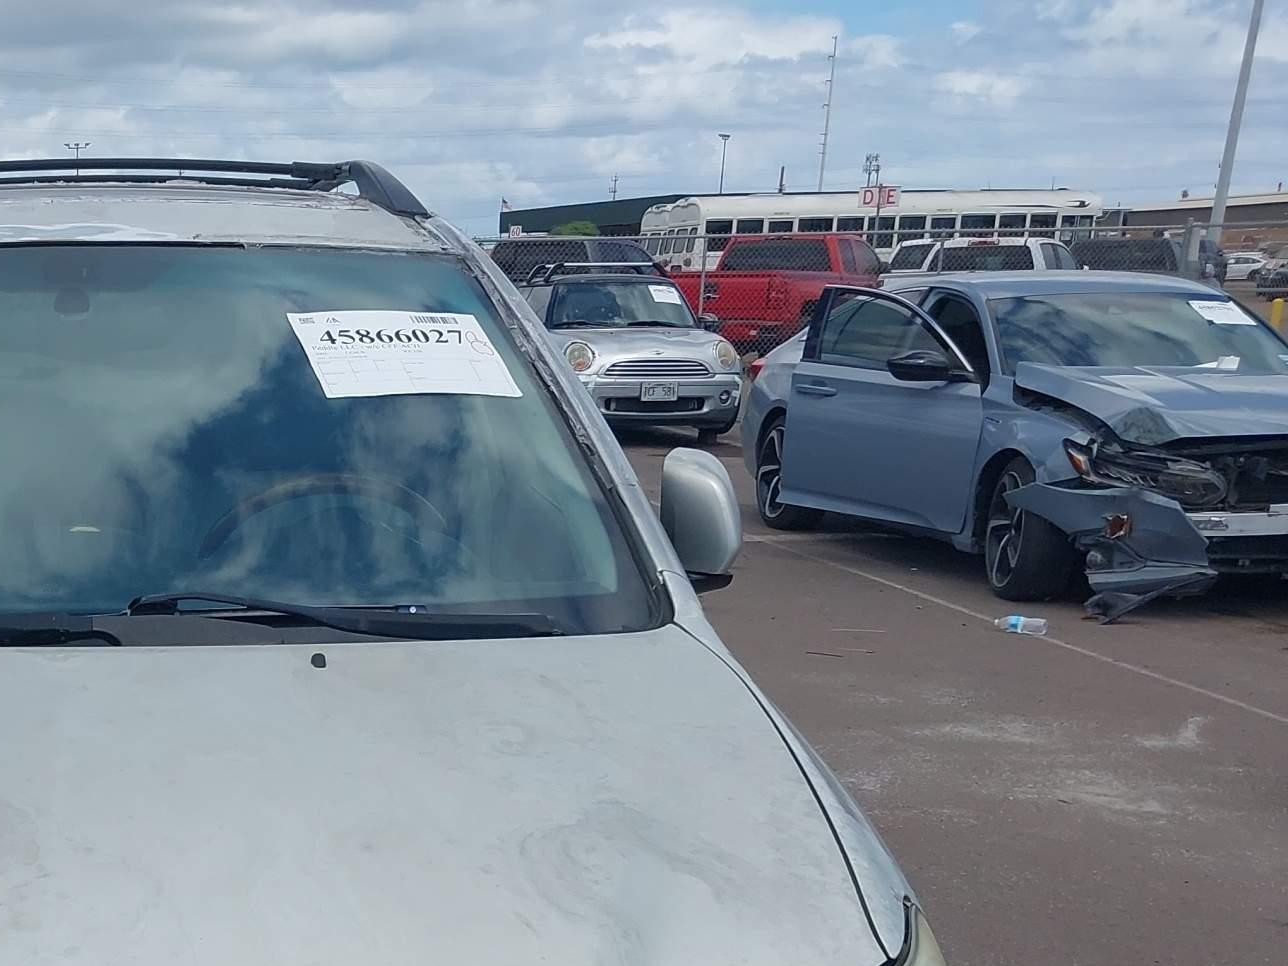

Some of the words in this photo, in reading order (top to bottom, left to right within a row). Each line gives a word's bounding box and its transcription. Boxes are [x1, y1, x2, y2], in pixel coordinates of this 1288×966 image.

[863, 189, 874, 205] D
[886, 188, 897, 205] E
[319, 327, 462, 345] 45866027
